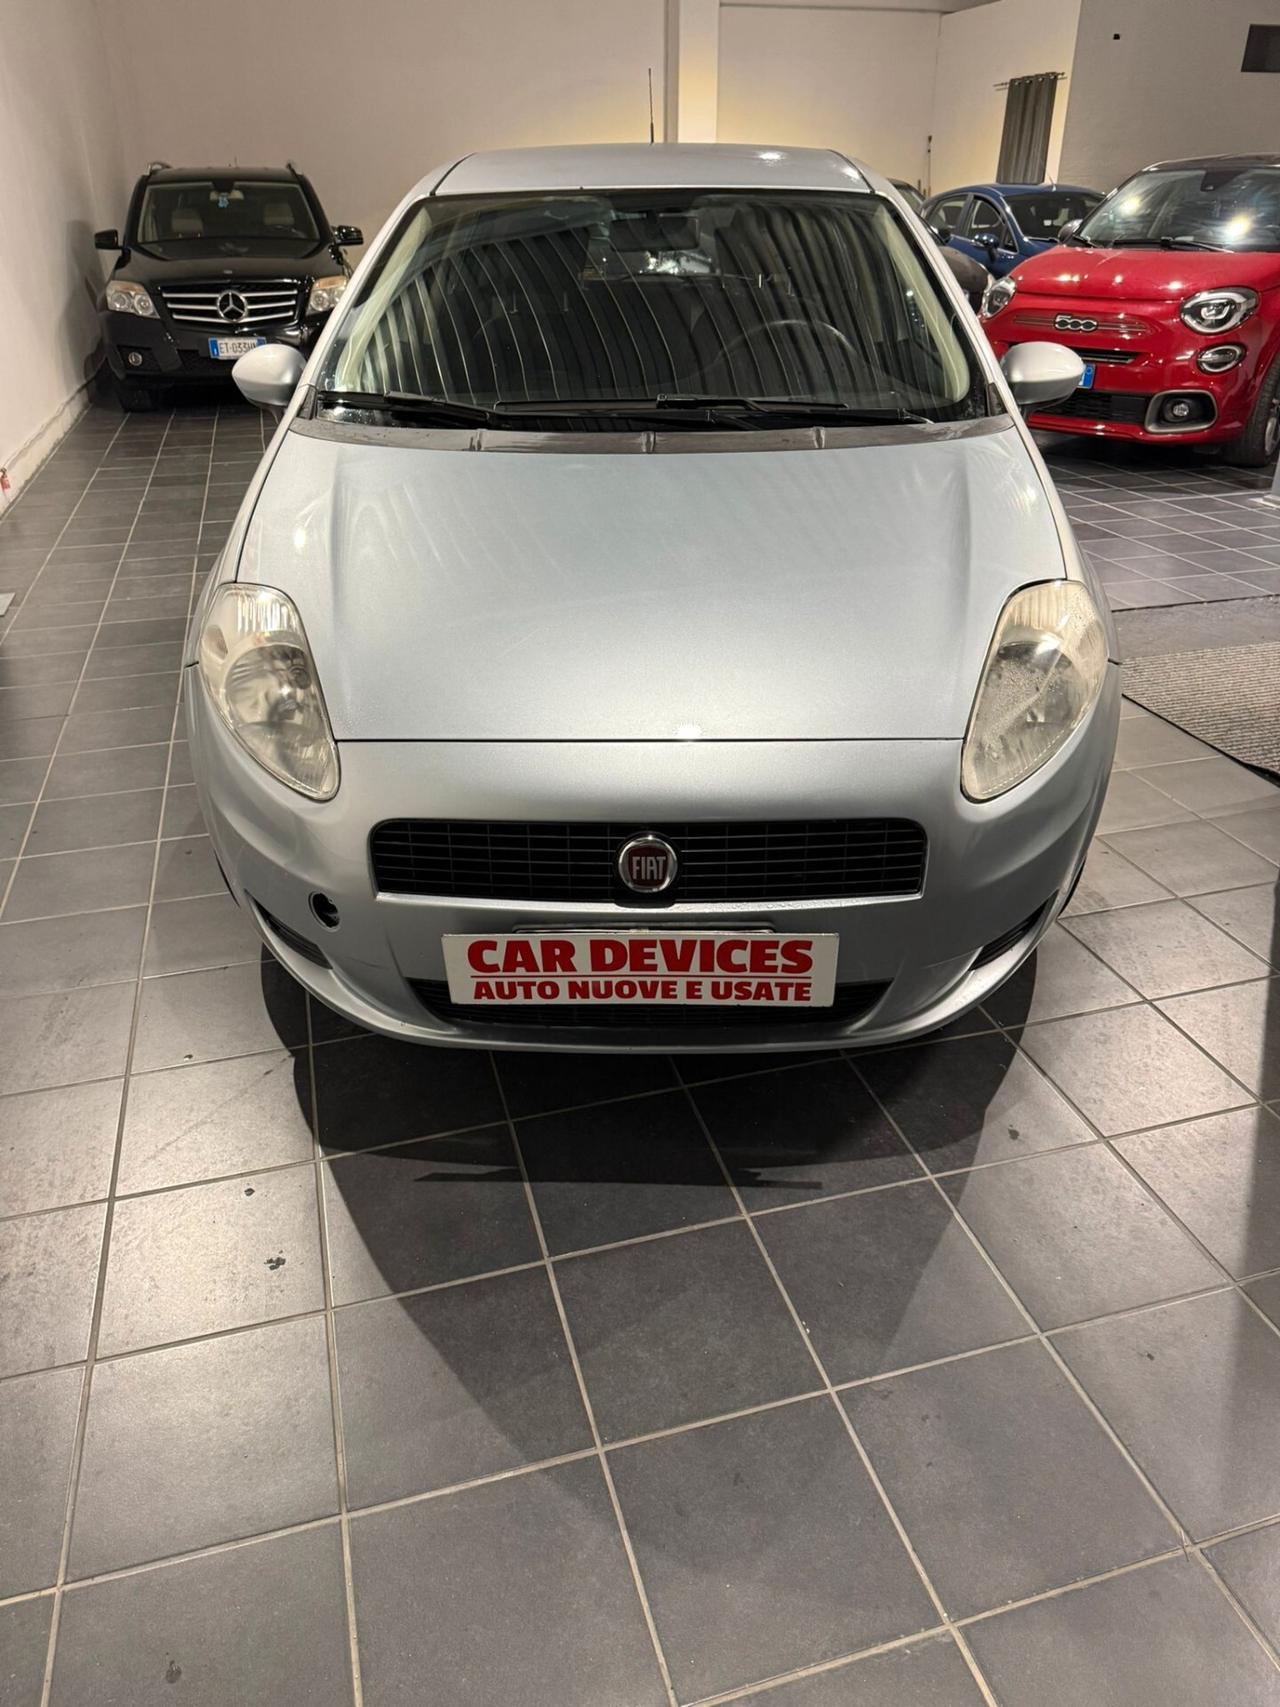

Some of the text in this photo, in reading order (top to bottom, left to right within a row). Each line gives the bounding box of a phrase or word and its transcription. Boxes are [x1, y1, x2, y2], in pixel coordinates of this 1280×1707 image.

[1055, 315, 1097, 331] 500
[632, 856, 666, 880] FIAT
[467, 939, 812, 974] CAR DEVICES
[473, 980, 812, 1002] AUTO NUOVE E USATE
